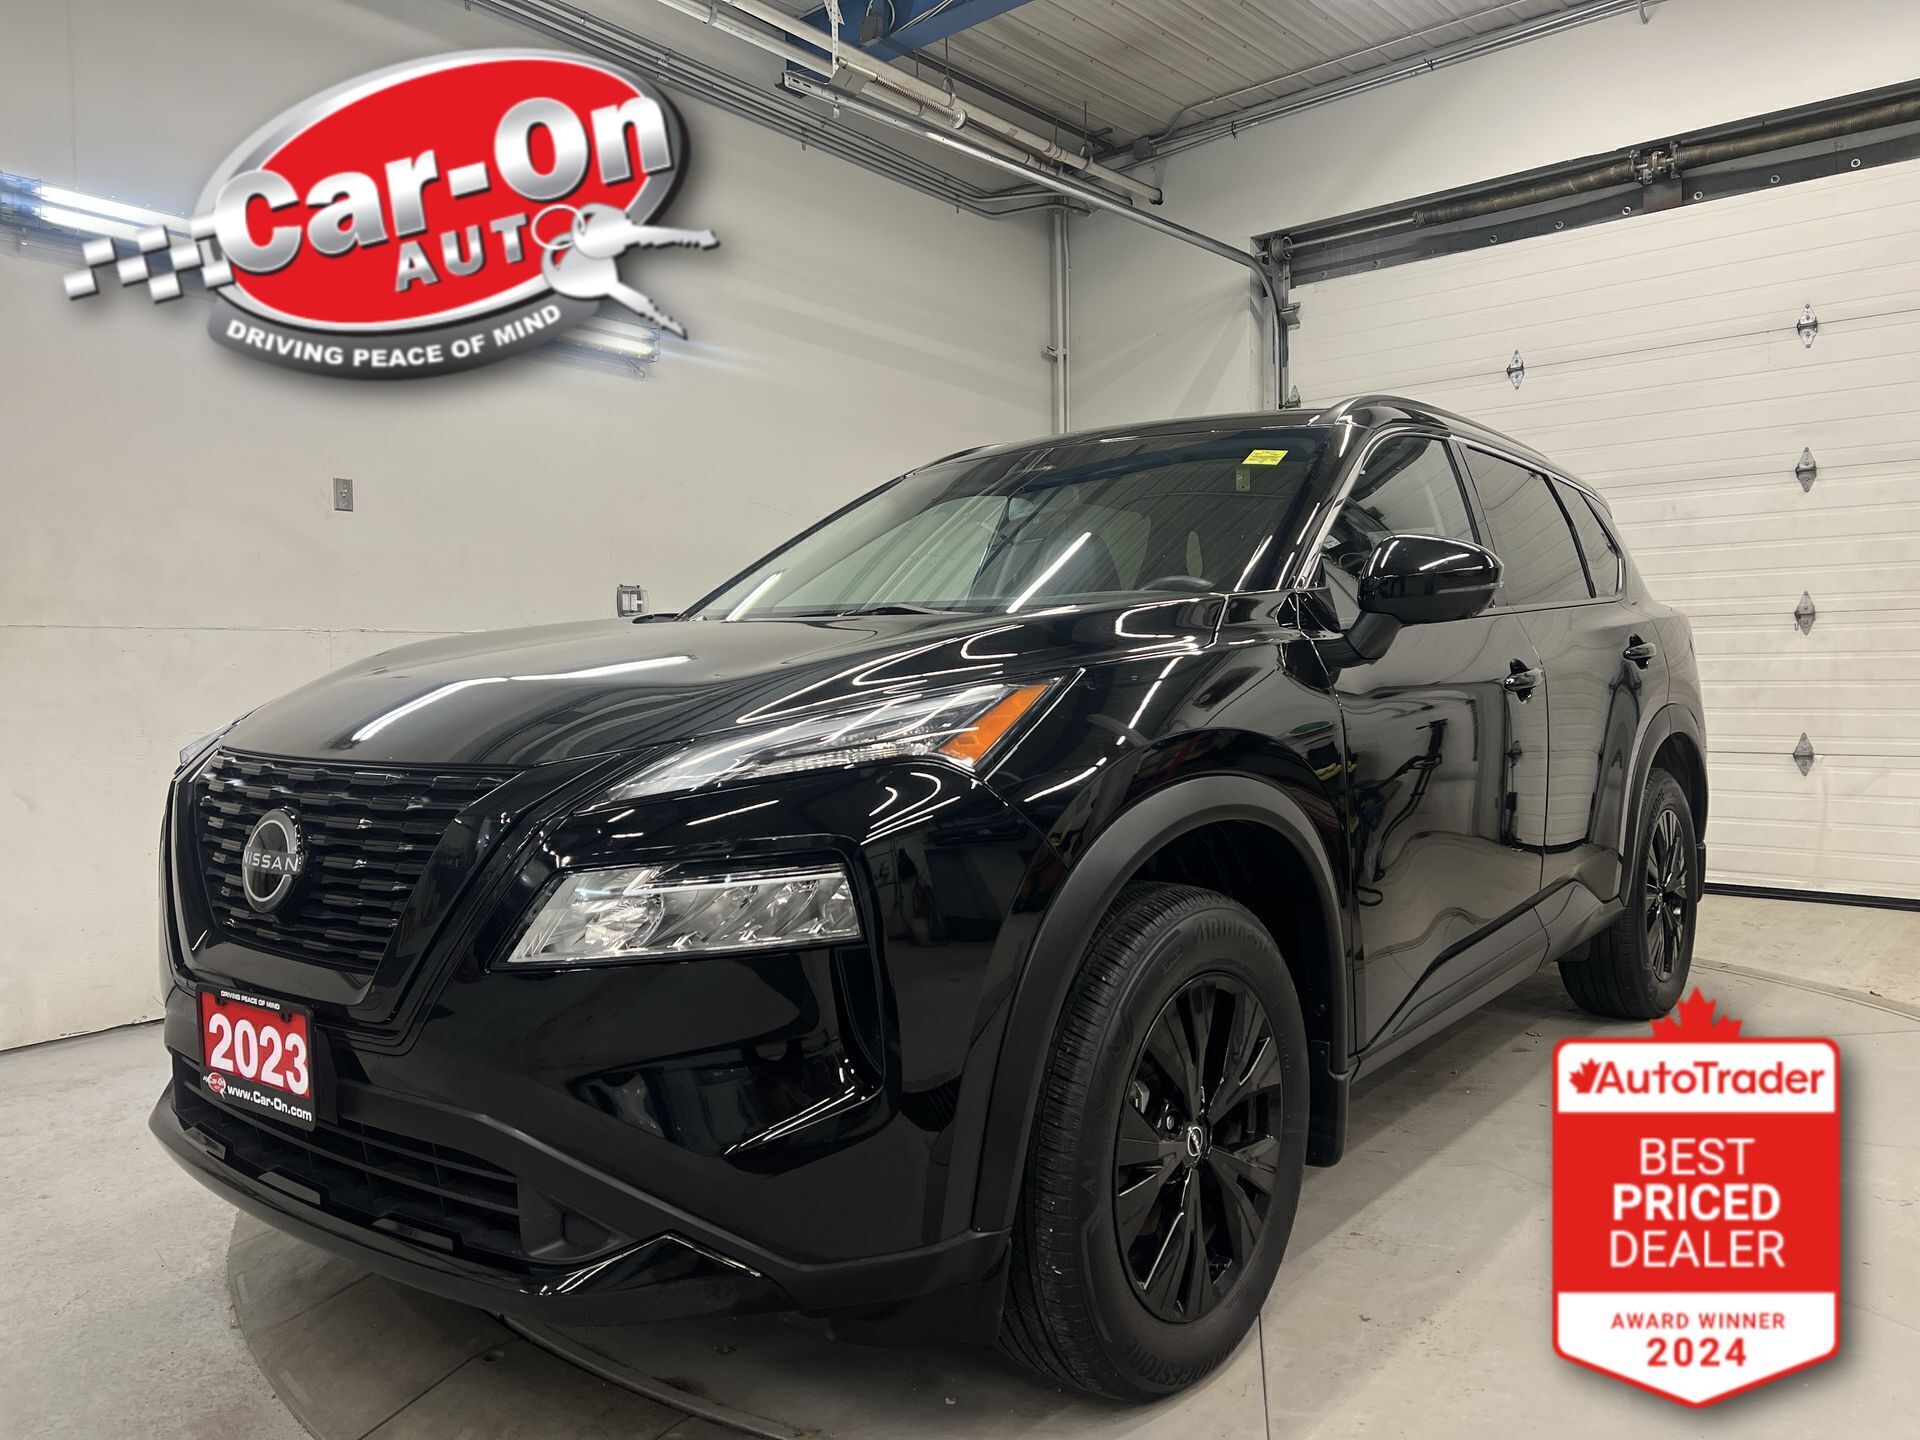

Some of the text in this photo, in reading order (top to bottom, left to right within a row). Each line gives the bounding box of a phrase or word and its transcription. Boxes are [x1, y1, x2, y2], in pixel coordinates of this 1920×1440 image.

[244, 849, 299, 872] NISSAN
[208, 1013, 309, 1095] 2023
[227, 1085, 312, 1122] www.Car-On.com
